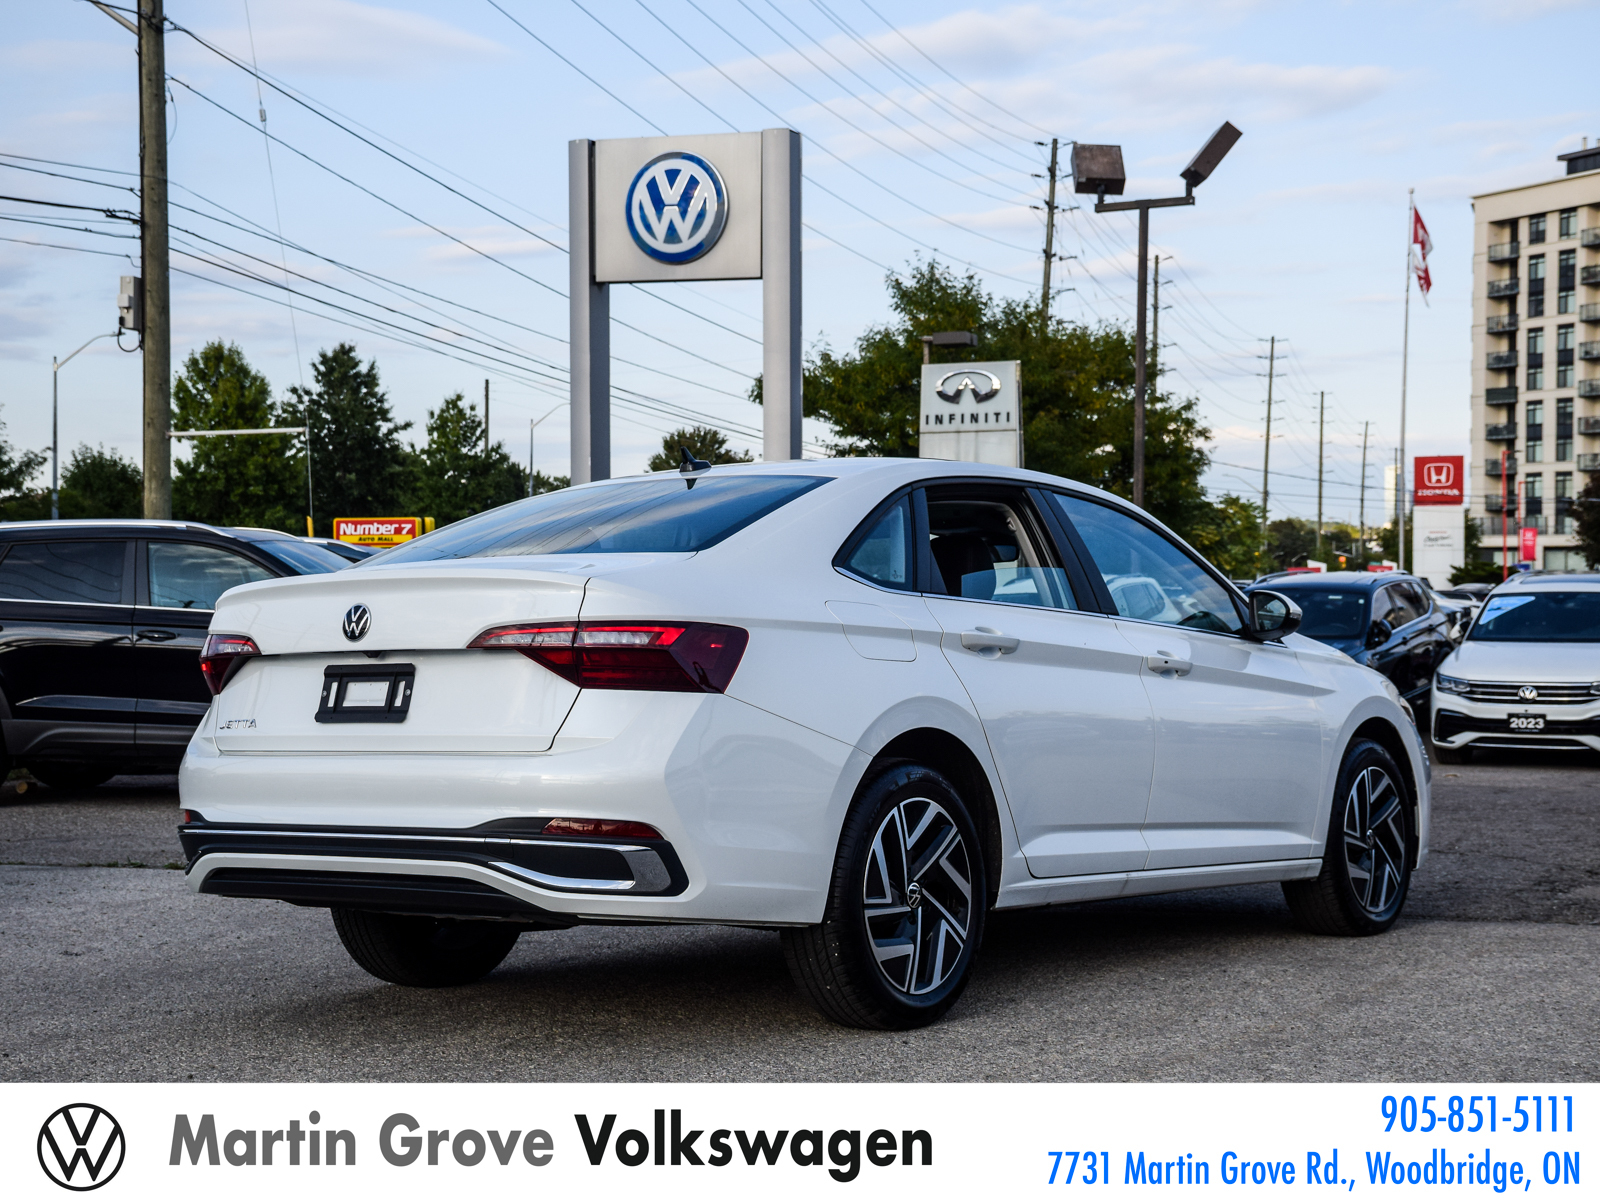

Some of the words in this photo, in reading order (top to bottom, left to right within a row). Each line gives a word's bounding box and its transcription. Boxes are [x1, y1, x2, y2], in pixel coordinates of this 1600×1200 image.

[925, 411, 1010, 425] INFINITI
[339, 522, 399, 535] Number
[401, 523, 412, 535] 7
[219, 718, 257, 730] JETTA
[1509, 717, 1545, 729] 2023
